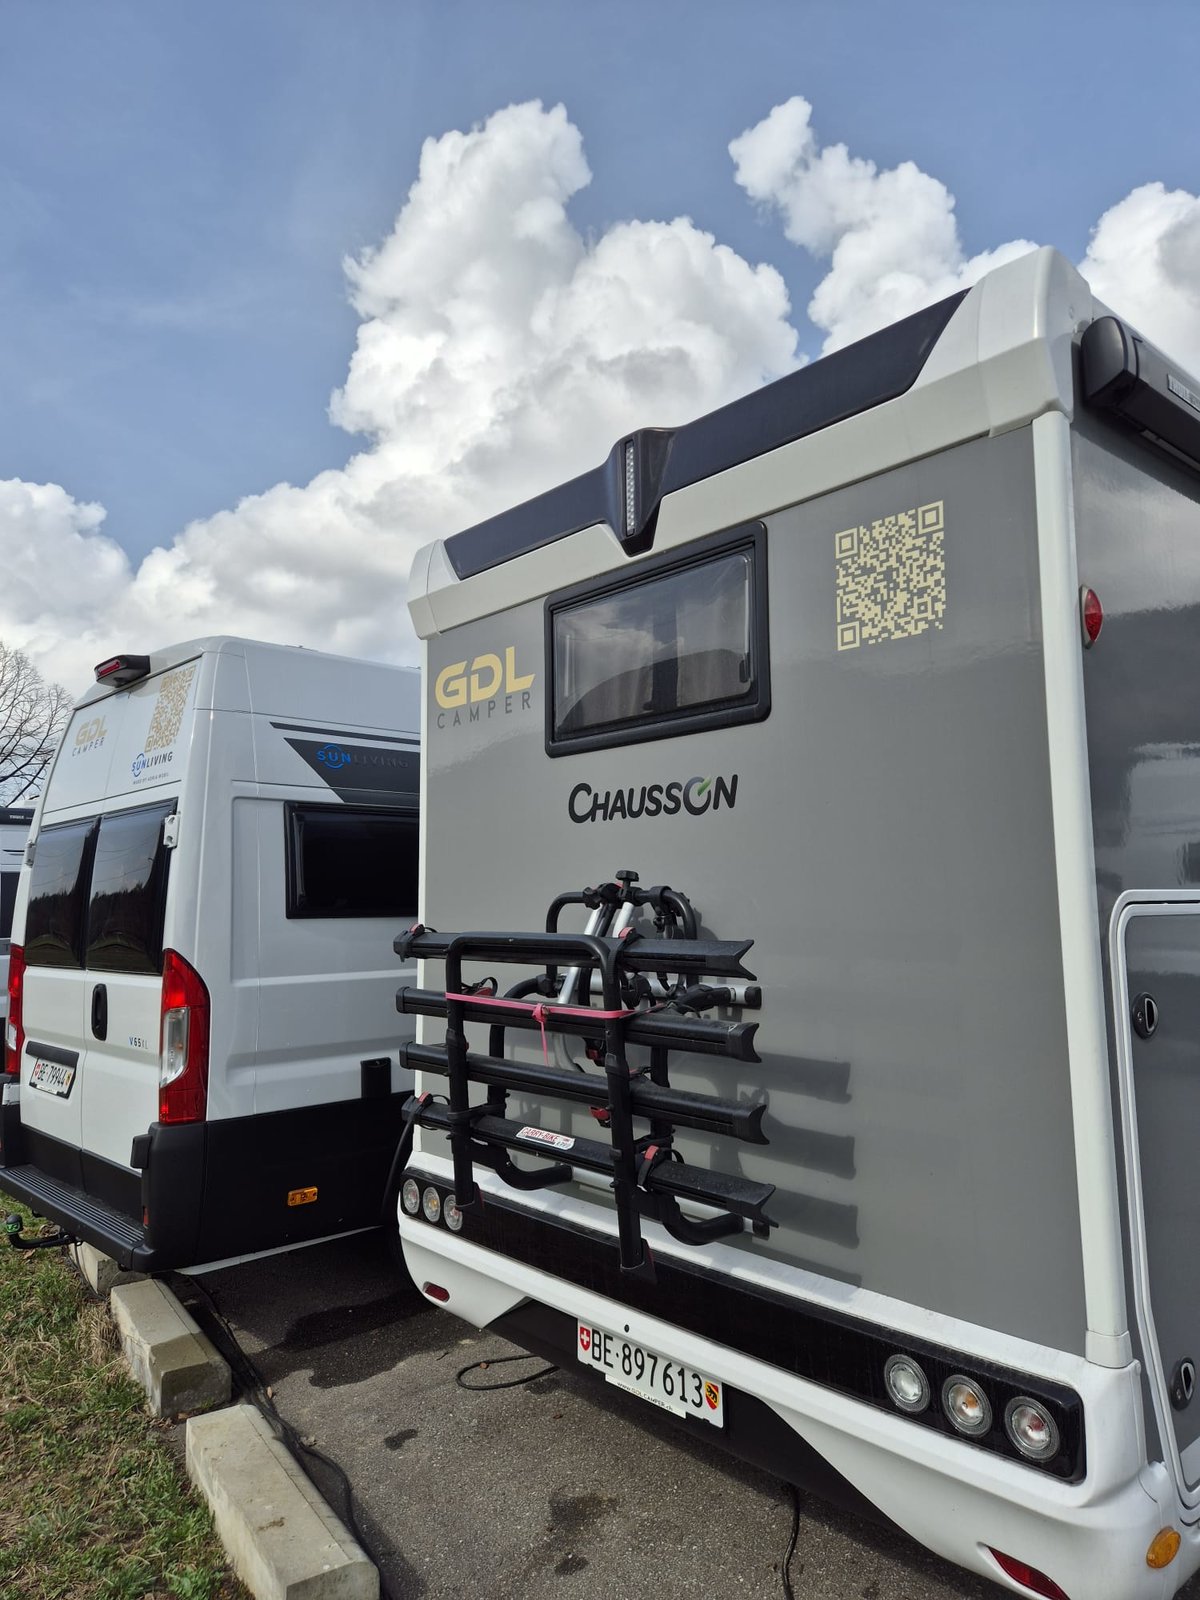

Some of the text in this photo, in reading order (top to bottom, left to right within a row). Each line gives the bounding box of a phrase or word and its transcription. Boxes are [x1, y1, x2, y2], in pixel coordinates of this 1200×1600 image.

[435, 646, 536, 710] GDL
[437, 691, 531, 729] CAMPER
[72, 737, 105, 757] CAMPER
[75, 715, 108, 746] GDL
[131, 752, 173, 773] SUNLIVING
[568, 774, 738, 824] CHAUSSON
